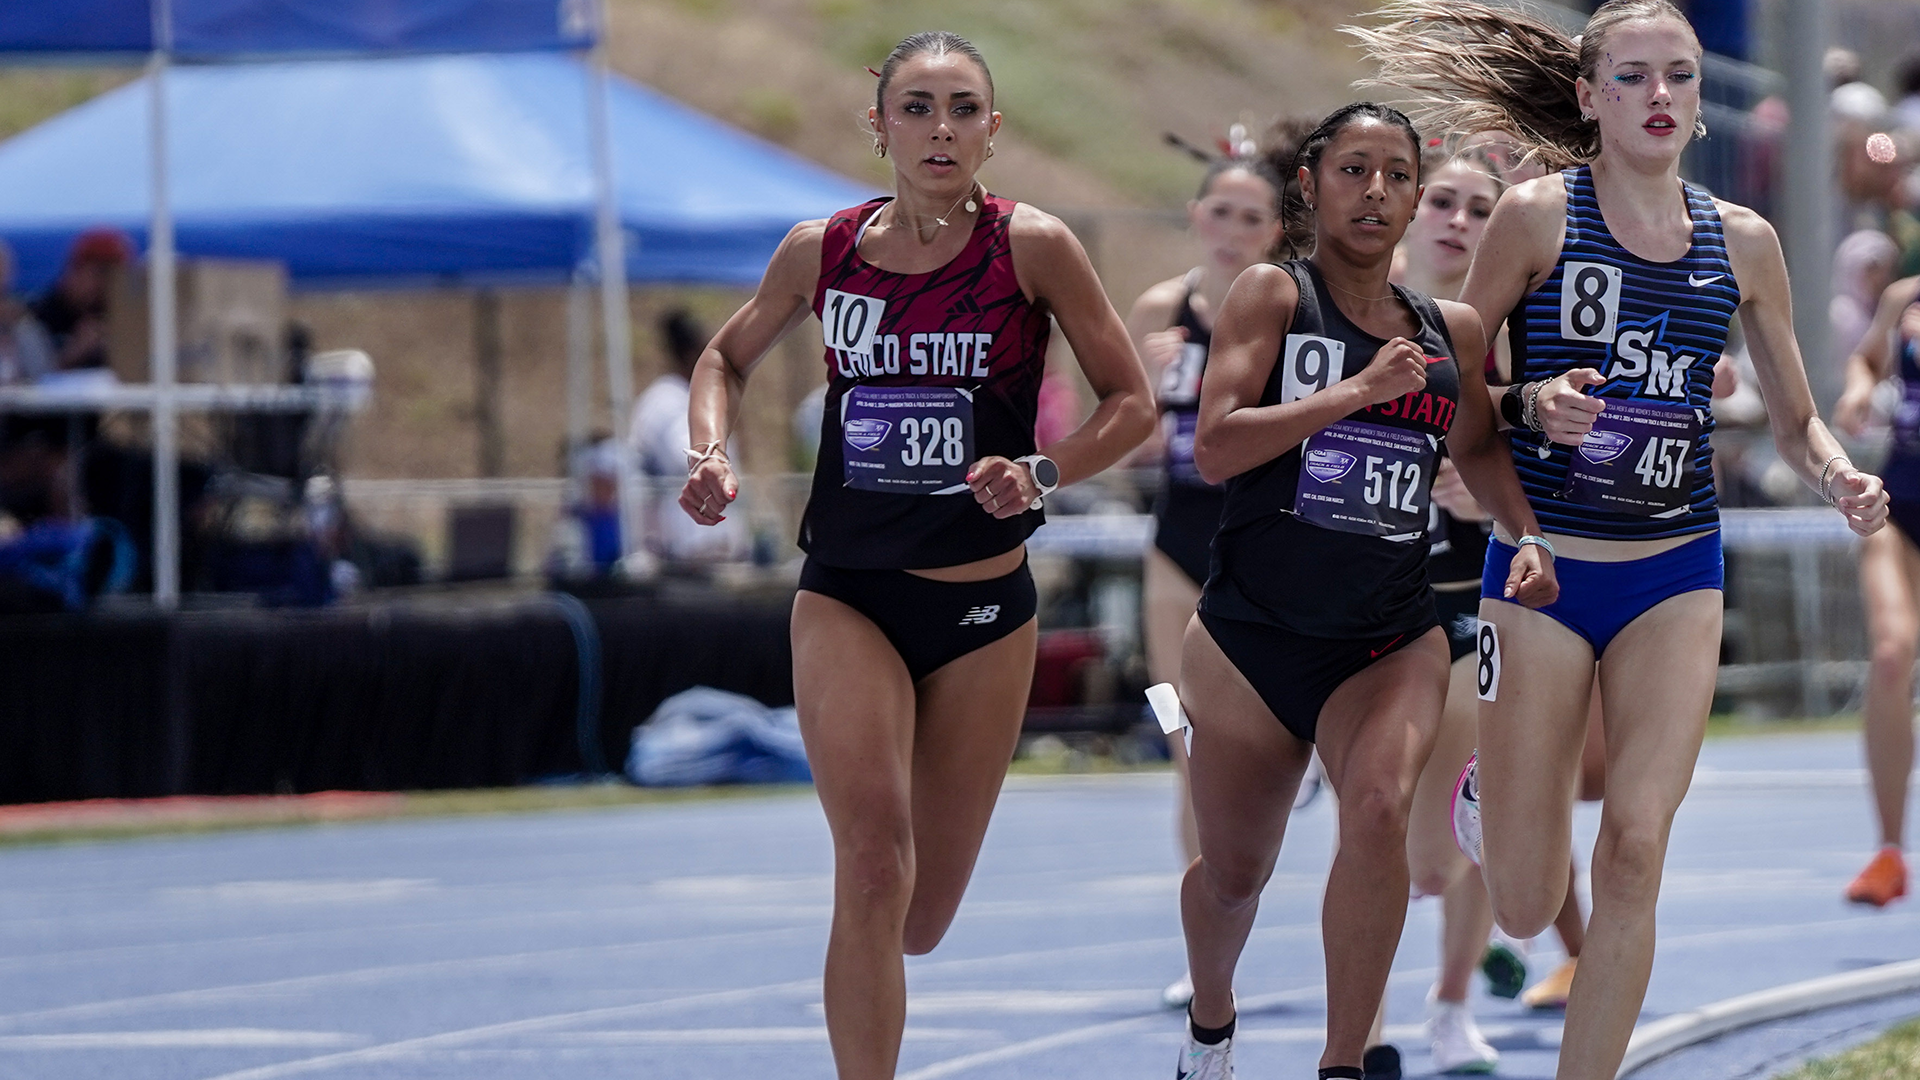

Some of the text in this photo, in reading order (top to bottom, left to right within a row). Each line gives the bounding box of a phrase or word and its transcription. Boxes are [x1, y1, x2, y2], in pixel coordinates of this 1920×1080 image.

[831, 294, 869, 348] 10
[1571, 266, 1609, 337] 8
[909, 333, 992, 377] STATE
[1294, 340, 1330, 400] 9
[1607, 330, 1696, 398] SM
[900, 417, 965, 467] 328
[1634, 436, 1691, 488] 457
[1363, 455, 1421, 514] 512
[1478, 625, 1496, 696] 8
